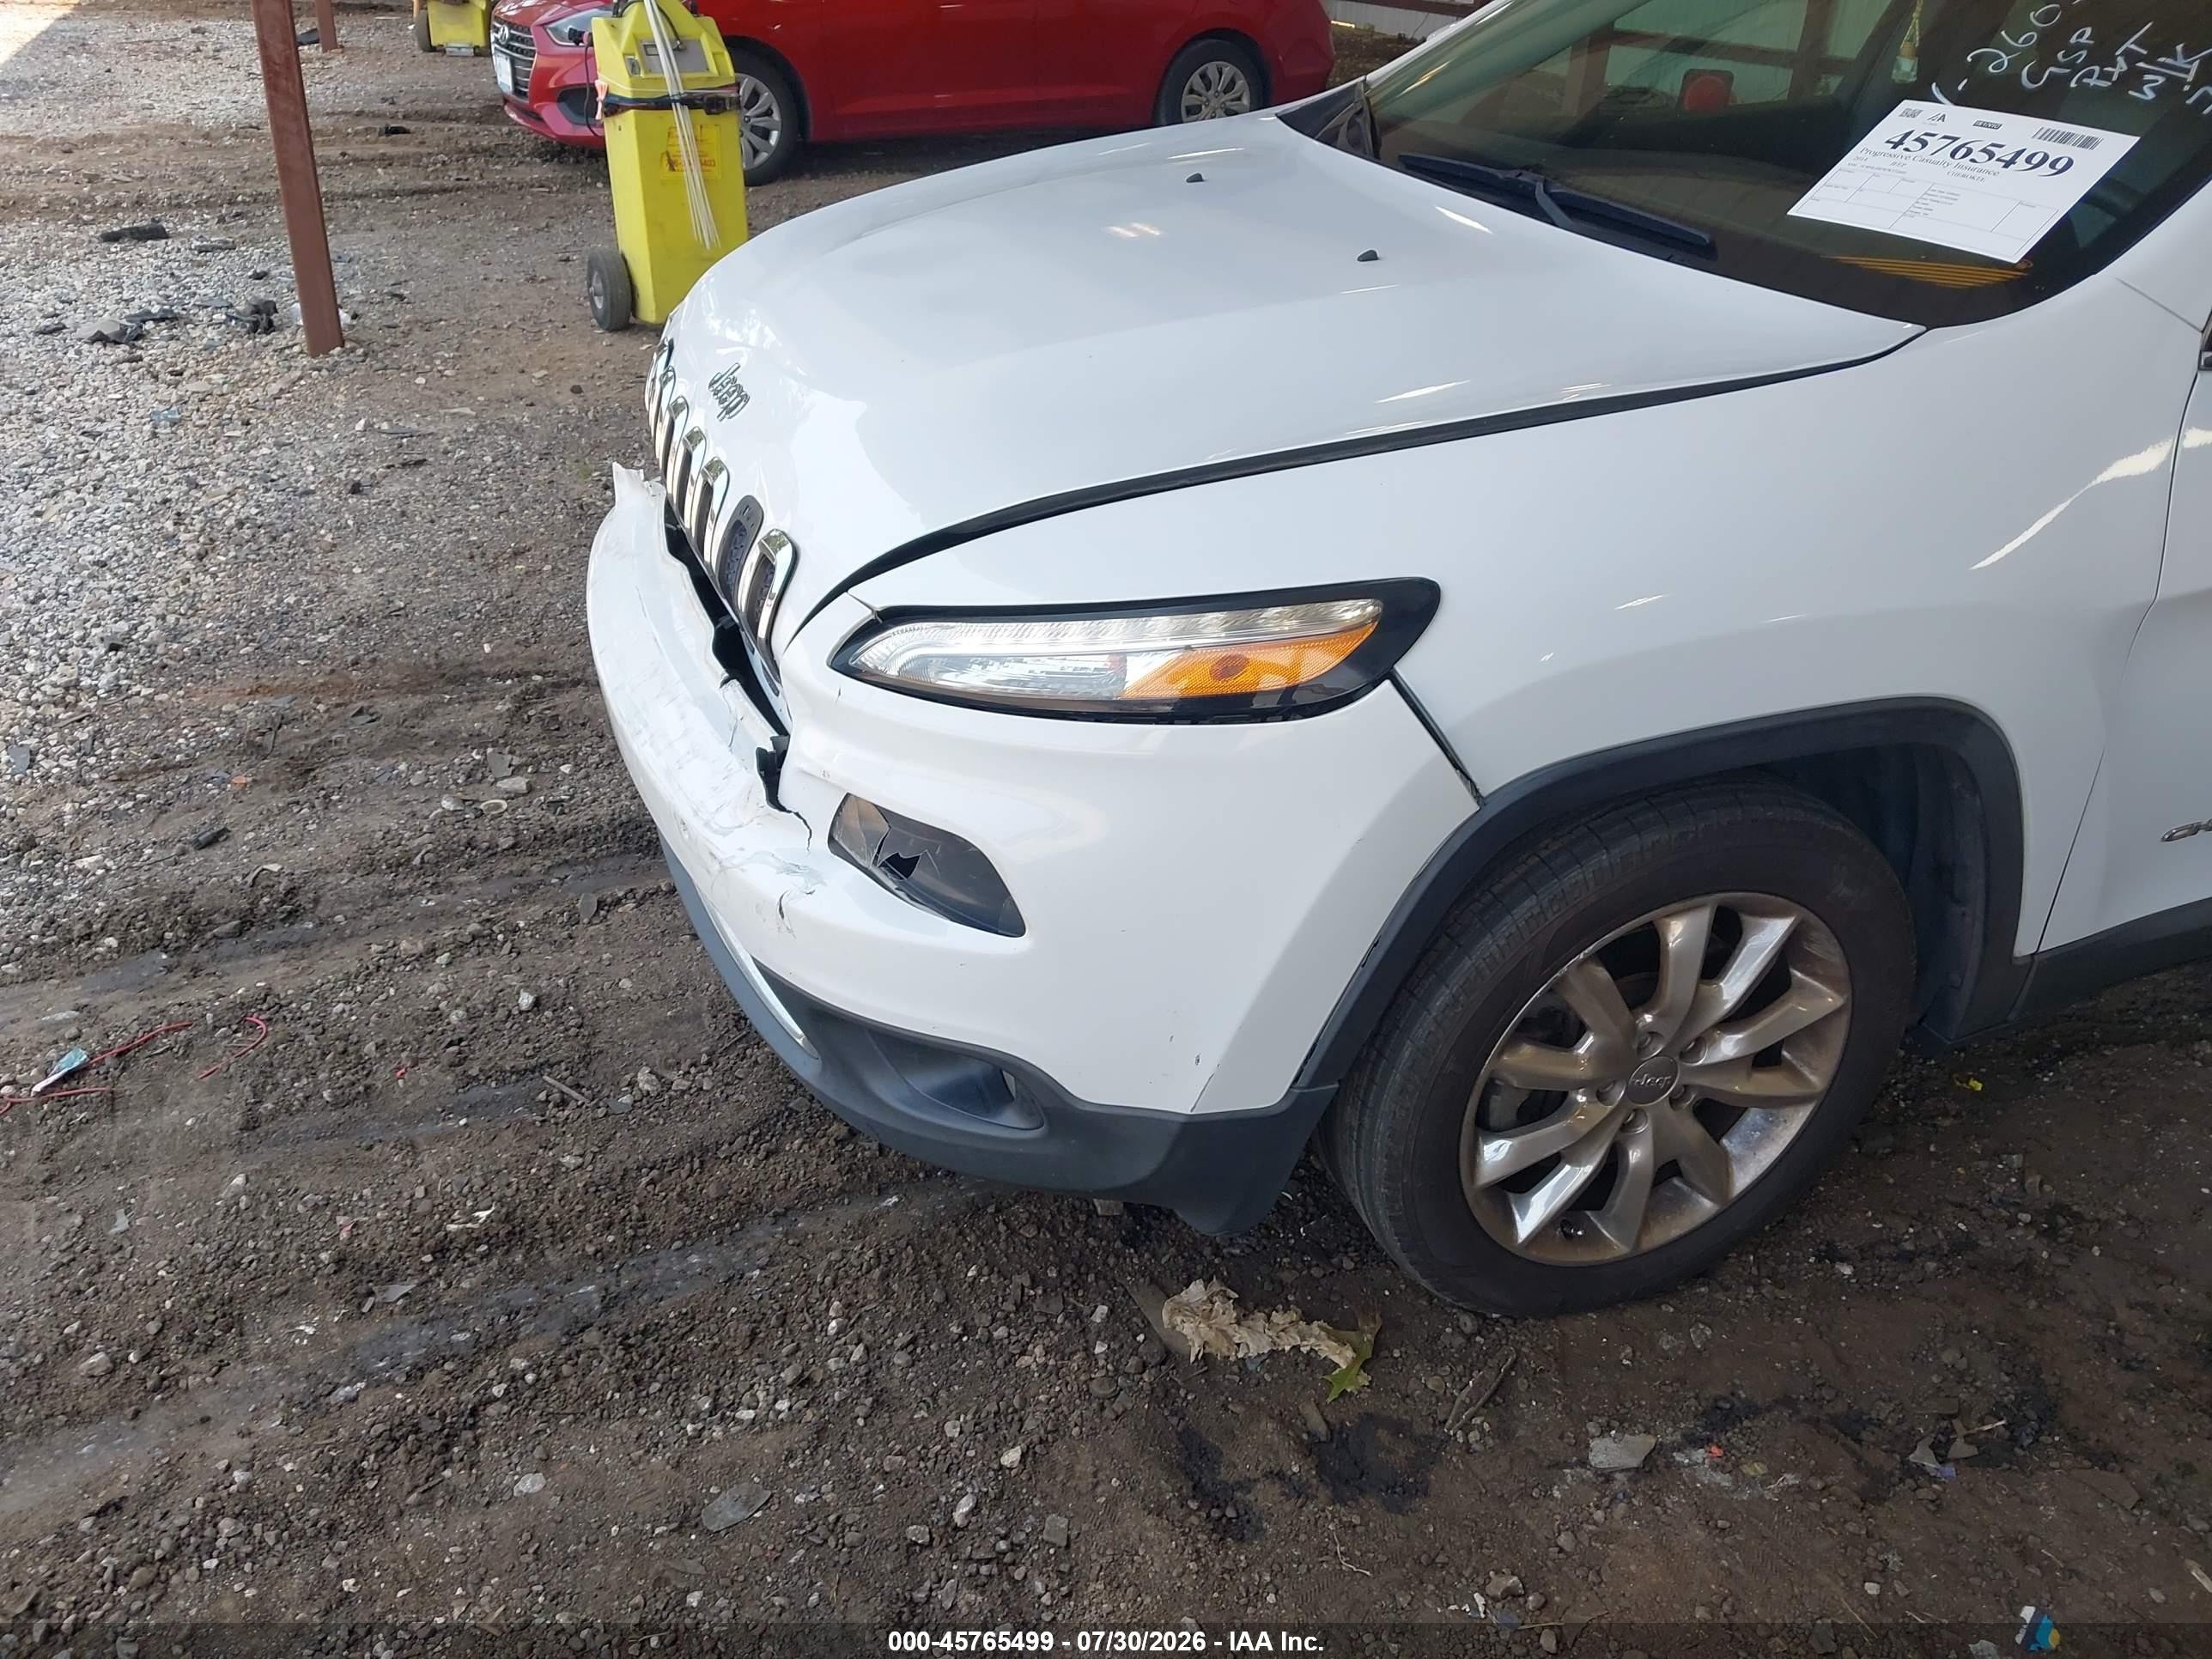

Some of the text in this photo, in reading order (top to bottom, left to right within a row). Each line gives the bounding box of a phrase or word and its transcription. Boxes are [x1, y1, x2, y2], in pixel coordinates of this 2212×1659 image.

[1859, 147, 1911, 161] Progressive
[1911, 155, 1953, 168] Casualty
[1953, 161, 2000, 177] Insurance
[1884, 129, 2075, 178] 45765499
[708, 362, 750, 422] Jeep
